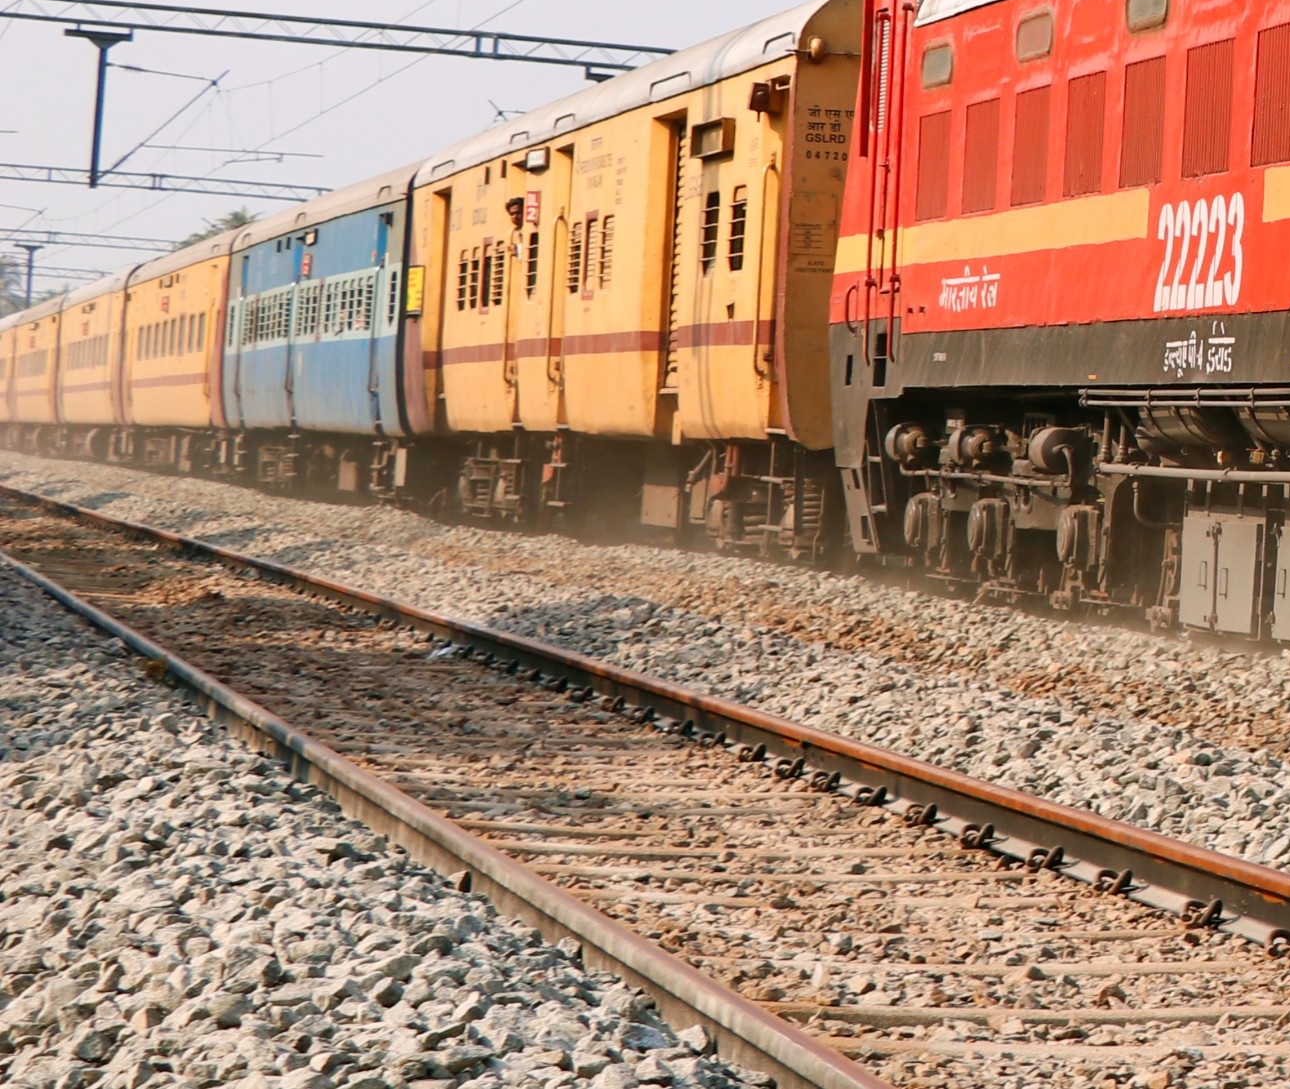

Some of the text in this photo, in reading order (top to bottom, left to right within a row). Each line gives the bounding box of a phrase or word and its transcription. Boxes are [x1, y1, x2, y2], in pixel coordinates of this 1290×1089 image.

[805, 132, 846, 144] GSLRD
[805, 150, 848, 162] 04720
[526, 207, 537, 220] 2
[1153, 191, 1245, 313] 22223
[939, 265, 1001, 312] भारतीय रेल
